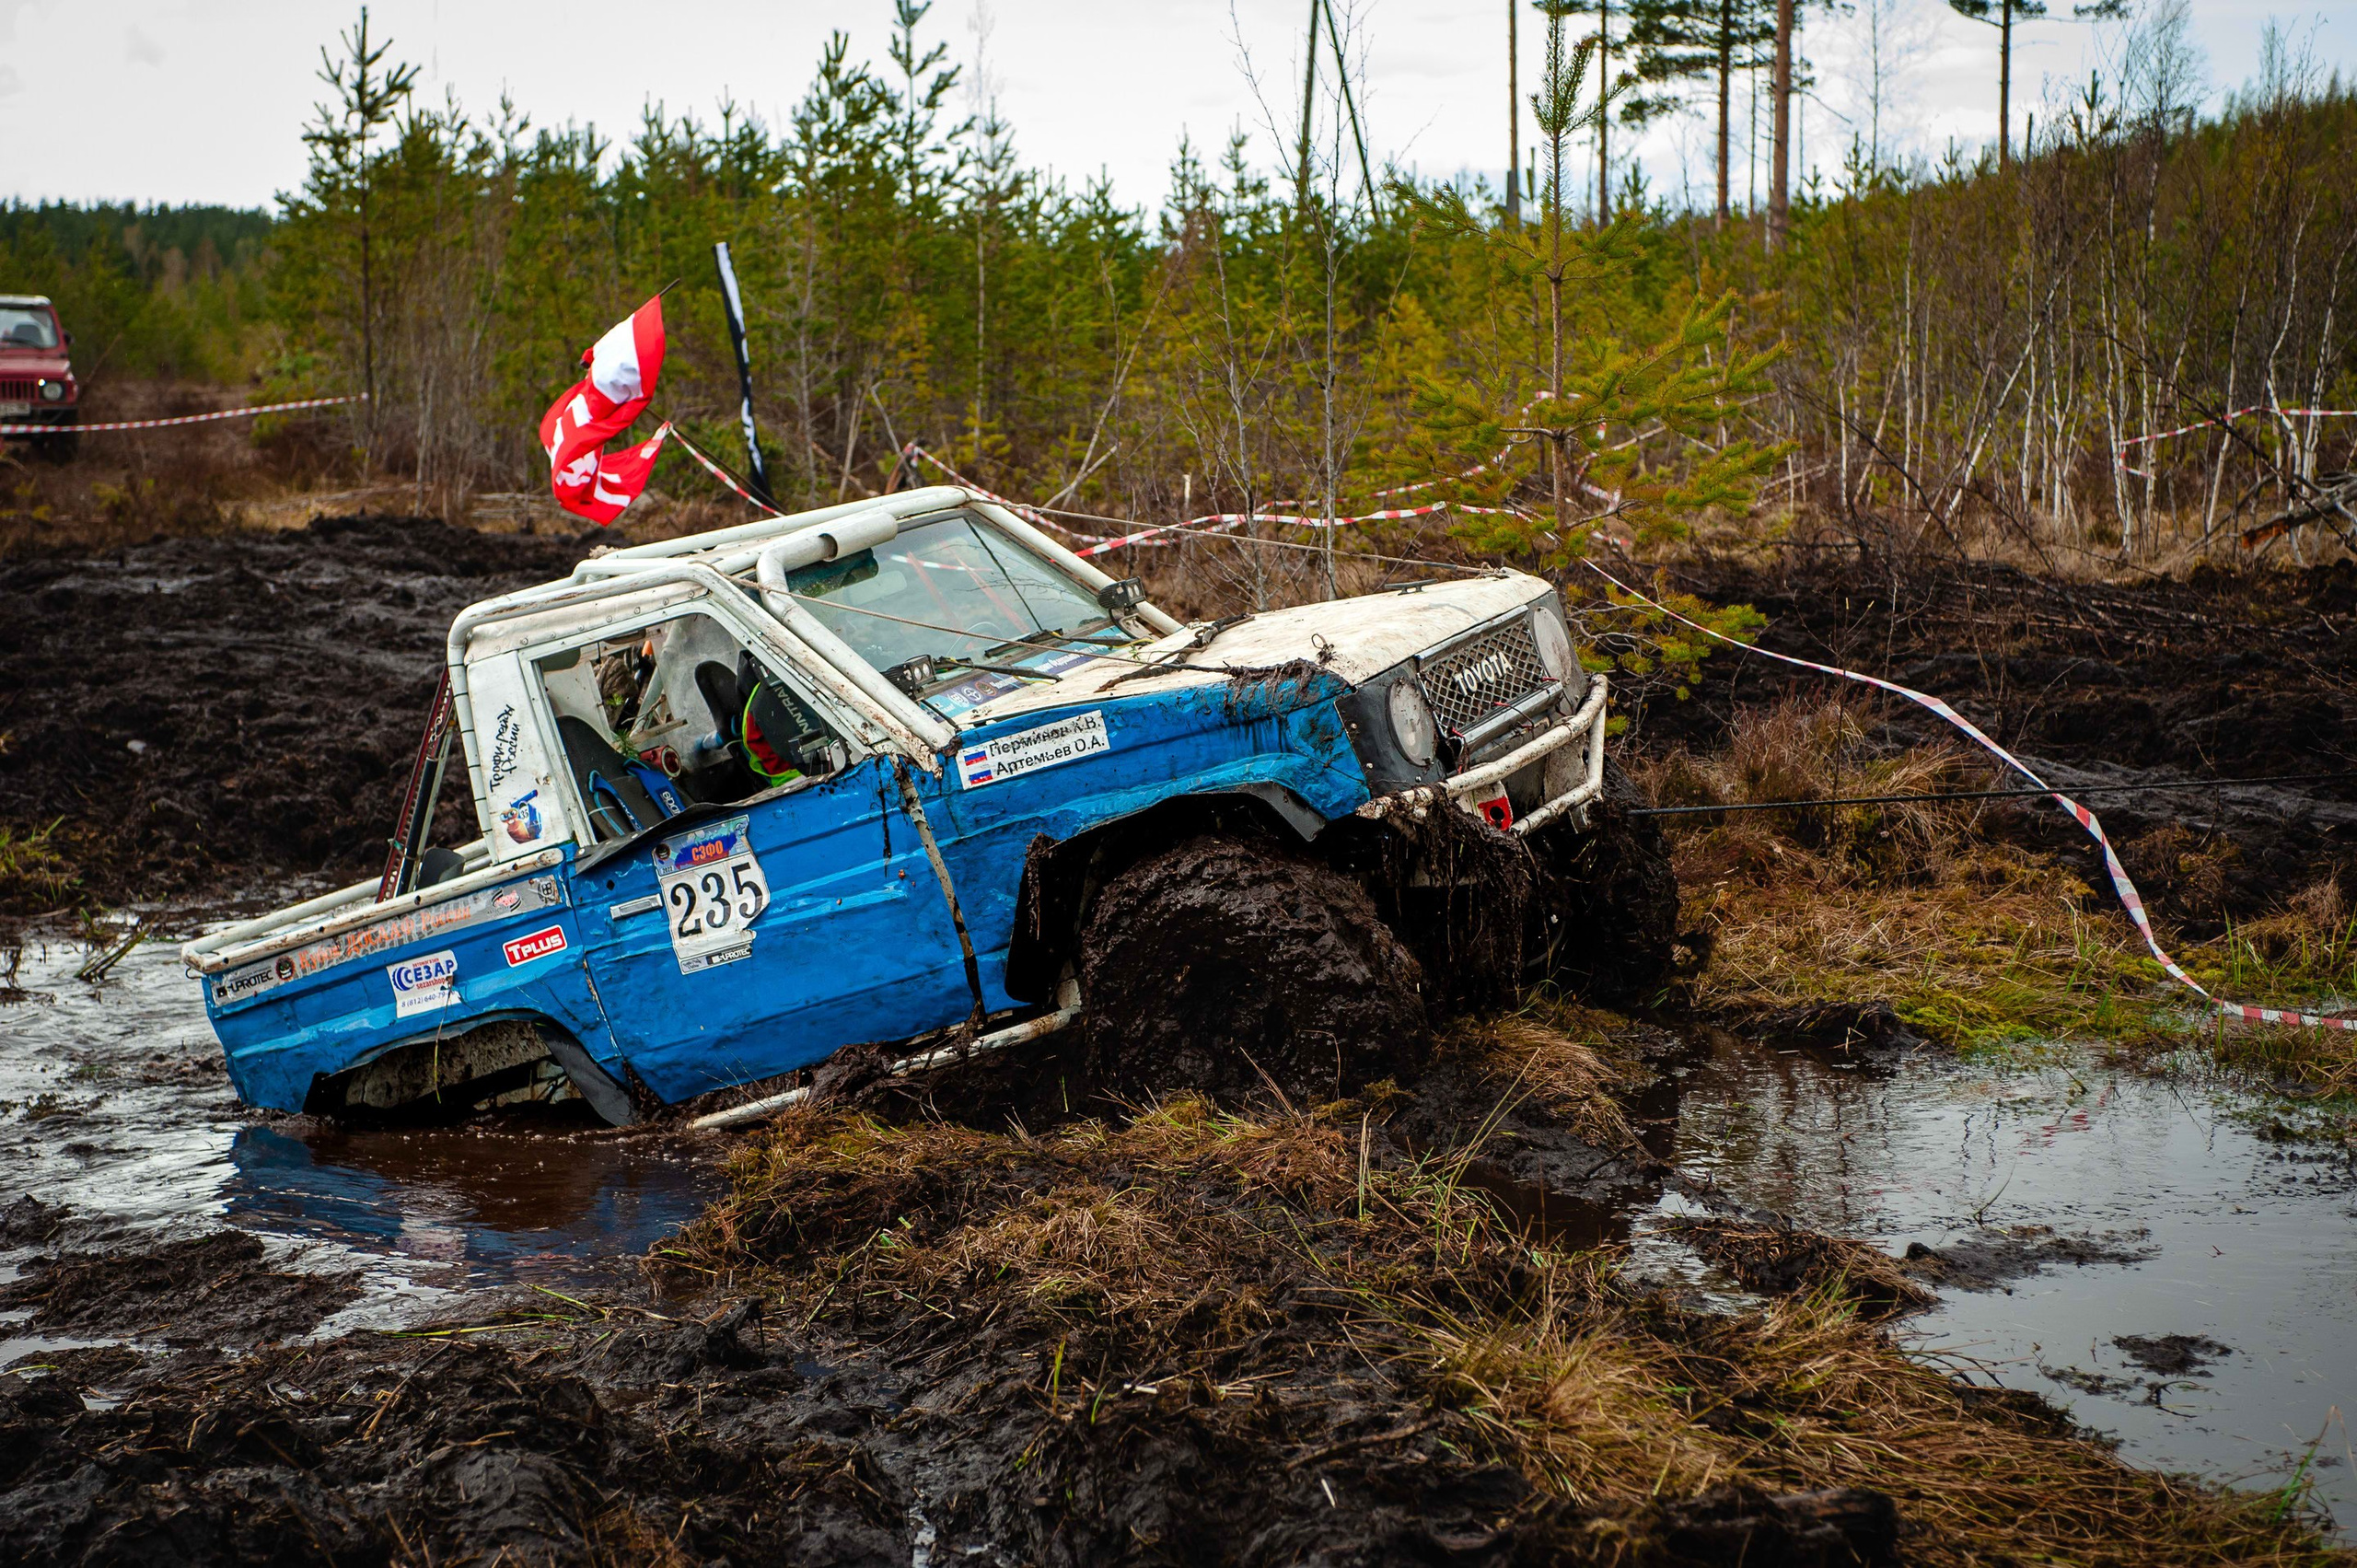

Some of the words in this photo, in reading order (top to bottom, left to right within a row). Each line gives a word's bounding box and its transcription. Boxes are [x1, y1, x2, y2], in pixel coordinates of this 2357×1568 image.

[1454, 651, 1513, 697] TOYOTA
[501, 724, 521, 774] России
[996, 746, 1071, 775] Артемьев
[1074, 735, 1105, 752] О.А.
[691, 841, 724, 861] СЗФО
[670, 862, 763, 939] 235
[346, 915, 414, 957] ДОСААФ
[421, 906, 471, 932] России
[718, 947, 750, 961] SUPROTEC
[407, 996, 424, 1007] (812)
